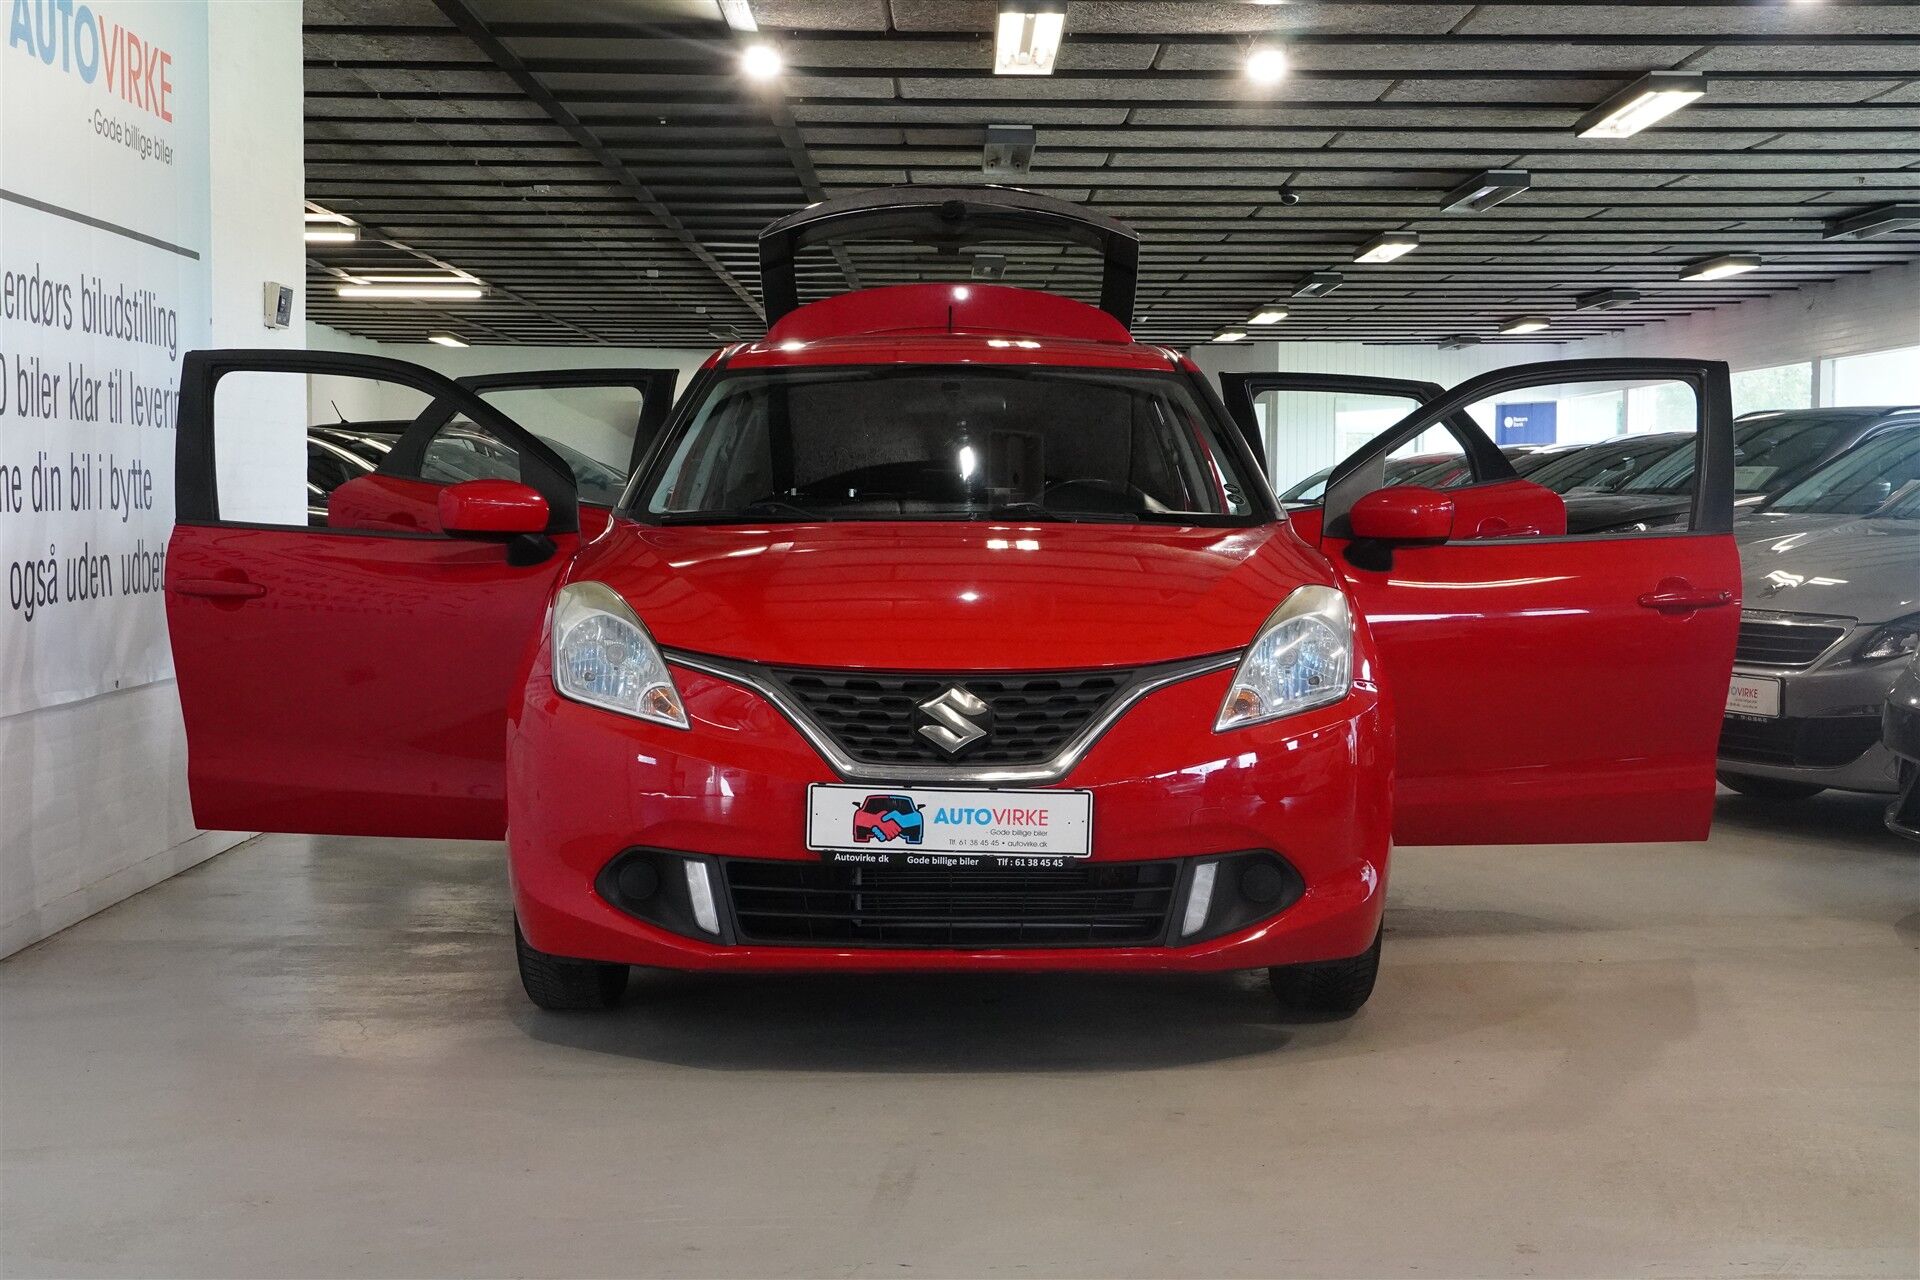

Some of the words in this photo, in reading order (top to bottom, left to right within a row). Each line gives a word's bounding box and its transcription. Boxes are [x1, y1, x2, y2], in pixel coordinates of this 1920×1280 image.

[9, 0, 172, 123] AUTOVIRKE
[94, 108, 122, 143] Gode
[124, 121, 152, 160] billige
[154, 135, 173, 166] biler
[0, 262, 72, 331] endørs
[81, 273, 177, 361] biludstilling
[16, 353, 60, 420] biler
[68, 362, 101, 422] klar
[108, 368, 122, 424] til
[32, 451, 61, 512] din
[70, 452, 90, 511] bil
[98, 453, 102, 510] i
[110, 453, 152, 523] bytte
[10, 543, 58, 622] også
[66, 541, 112, 602] uden
[1729, 686, 1758, 699] OVIRKE
[933, 807, 1048, 826] AUTOVIRKE
[990, 828, 1010, 836] Gode
[1011, 828, 1032, 838] billige
[1033, 829, 1048, 837] biler
[834, 853, 876, 863] Autovirke
[878, 854, 889, 863] dk
[907, 855, 930, 865] Gode
[931, 856, 958, 867] billige
[959, 857, 979, 866] biler
[997, 857, 1009, 867] Tlf
[1015, 858, 1026, 867] 61
[1027, 858, 1038, 867] 38
[1039, 858, 1051, 867] 45
[1052, 858, 1064, 867] 45
